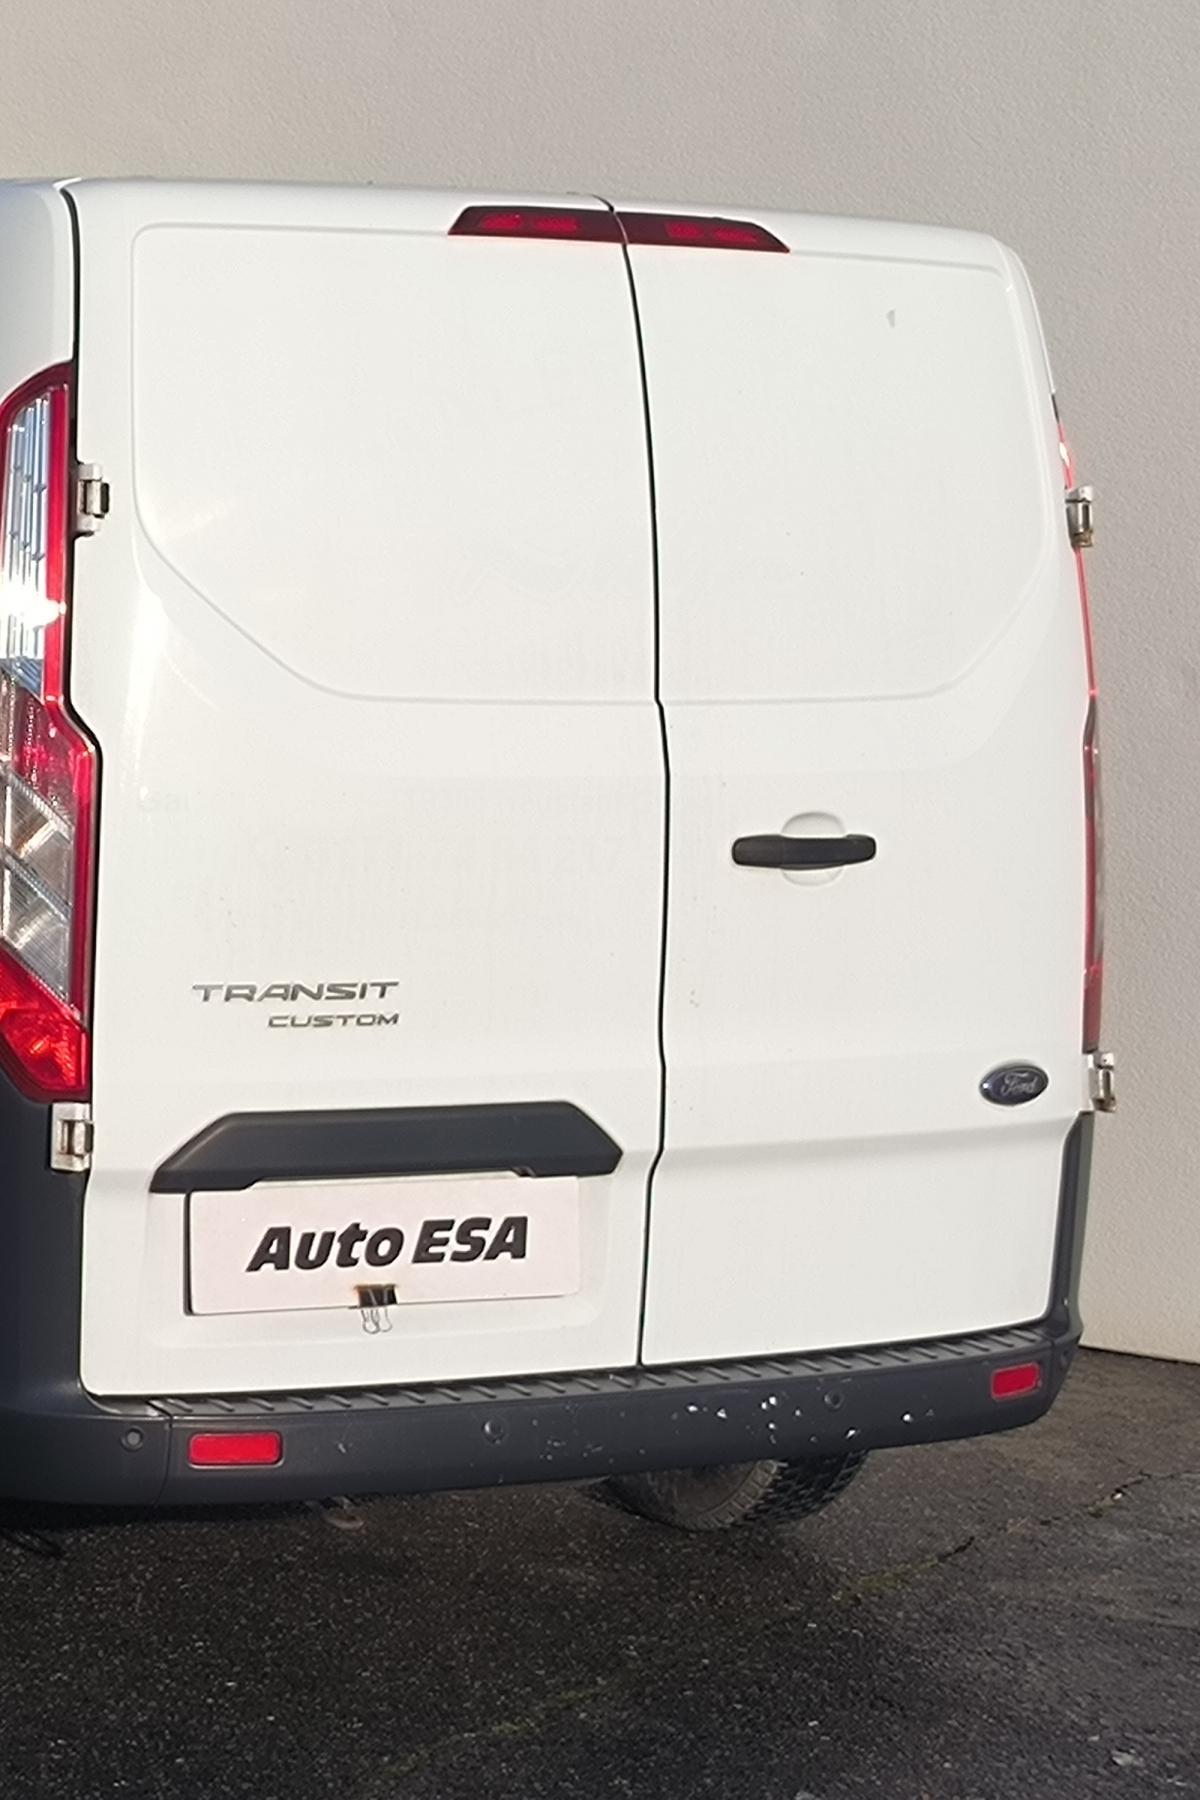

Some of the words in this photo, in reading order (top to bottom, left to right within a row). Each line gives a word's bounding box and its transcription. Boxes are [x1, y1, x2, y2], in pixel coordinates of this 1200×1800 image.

[192, 981, 399, 1002] TRANSIT
[268, 1013, 399, 1028] CUSTOM
[1001, 1072, 1038, 1096] Ford
[245, 1222, 404, 1272] Auto
[411, 1216, 528, 1264] ESA
